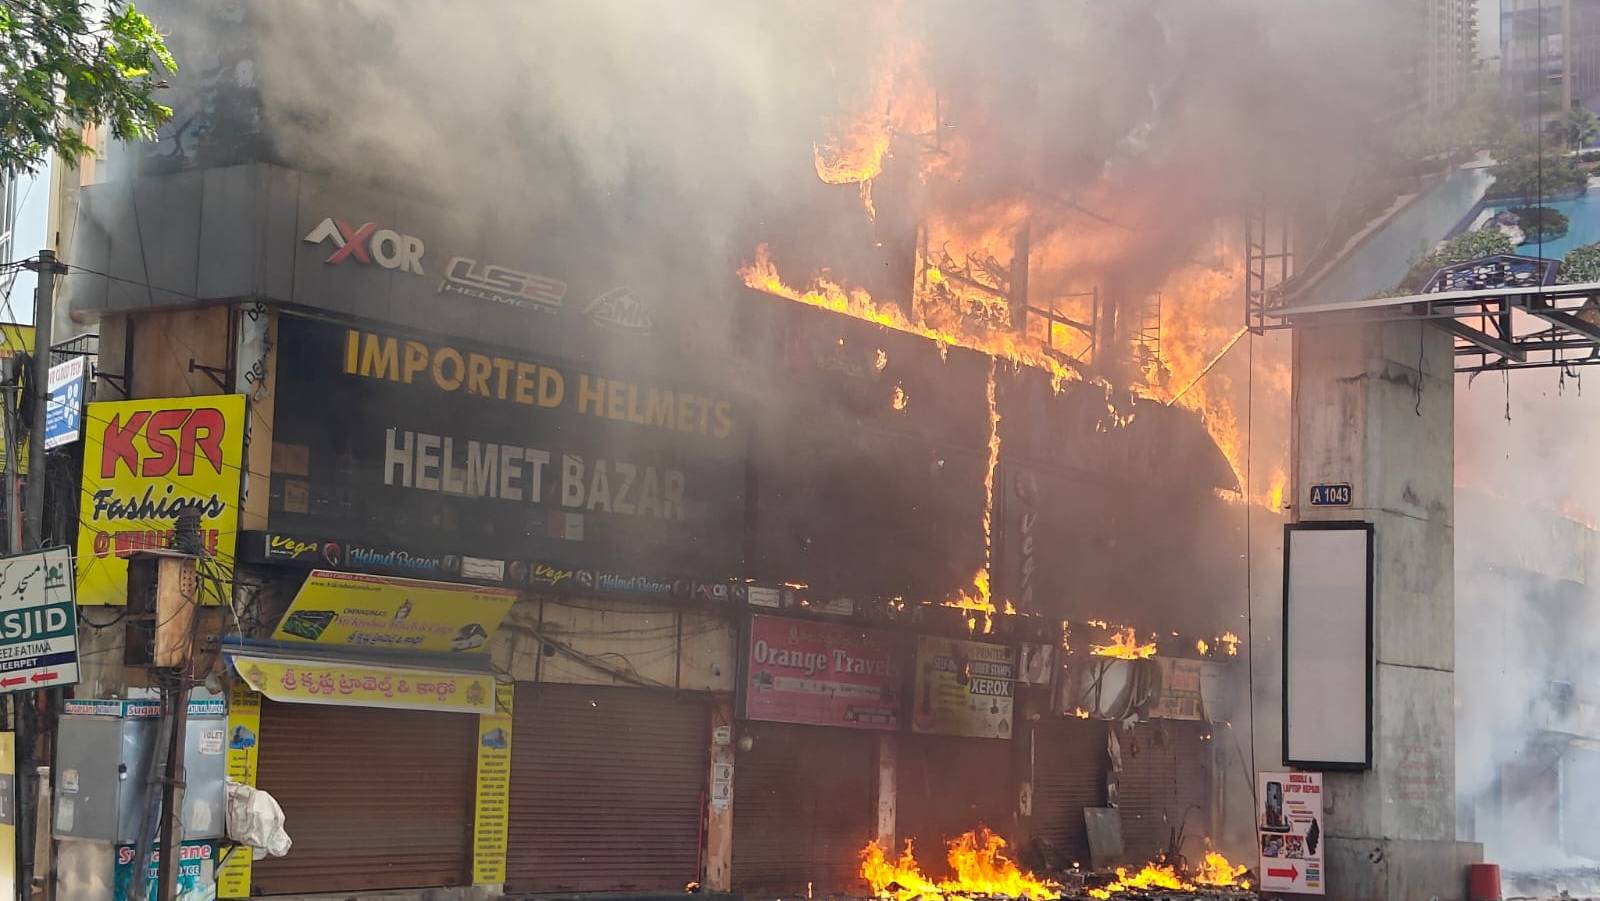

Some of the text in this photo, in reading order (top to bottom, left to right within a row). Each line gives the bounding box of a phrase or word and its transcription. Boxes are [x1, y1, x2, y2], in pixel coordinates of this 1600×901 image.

[304, 217, 425, 276] AXOR
[345, 329, 734, 439] IMPORTED HELMETS
[101, 408, 225, 479] KSR
[384, 428, 686, 521] HELMET BAZAR
[93, 485, 225, 520] Fashions
[1313, 488, 1349, 502] A 1043
[15, 641, 52, 657] FATIMA
[754, 640, 827, 675] Orange
[971, 677, 1009, 696] XEROX
